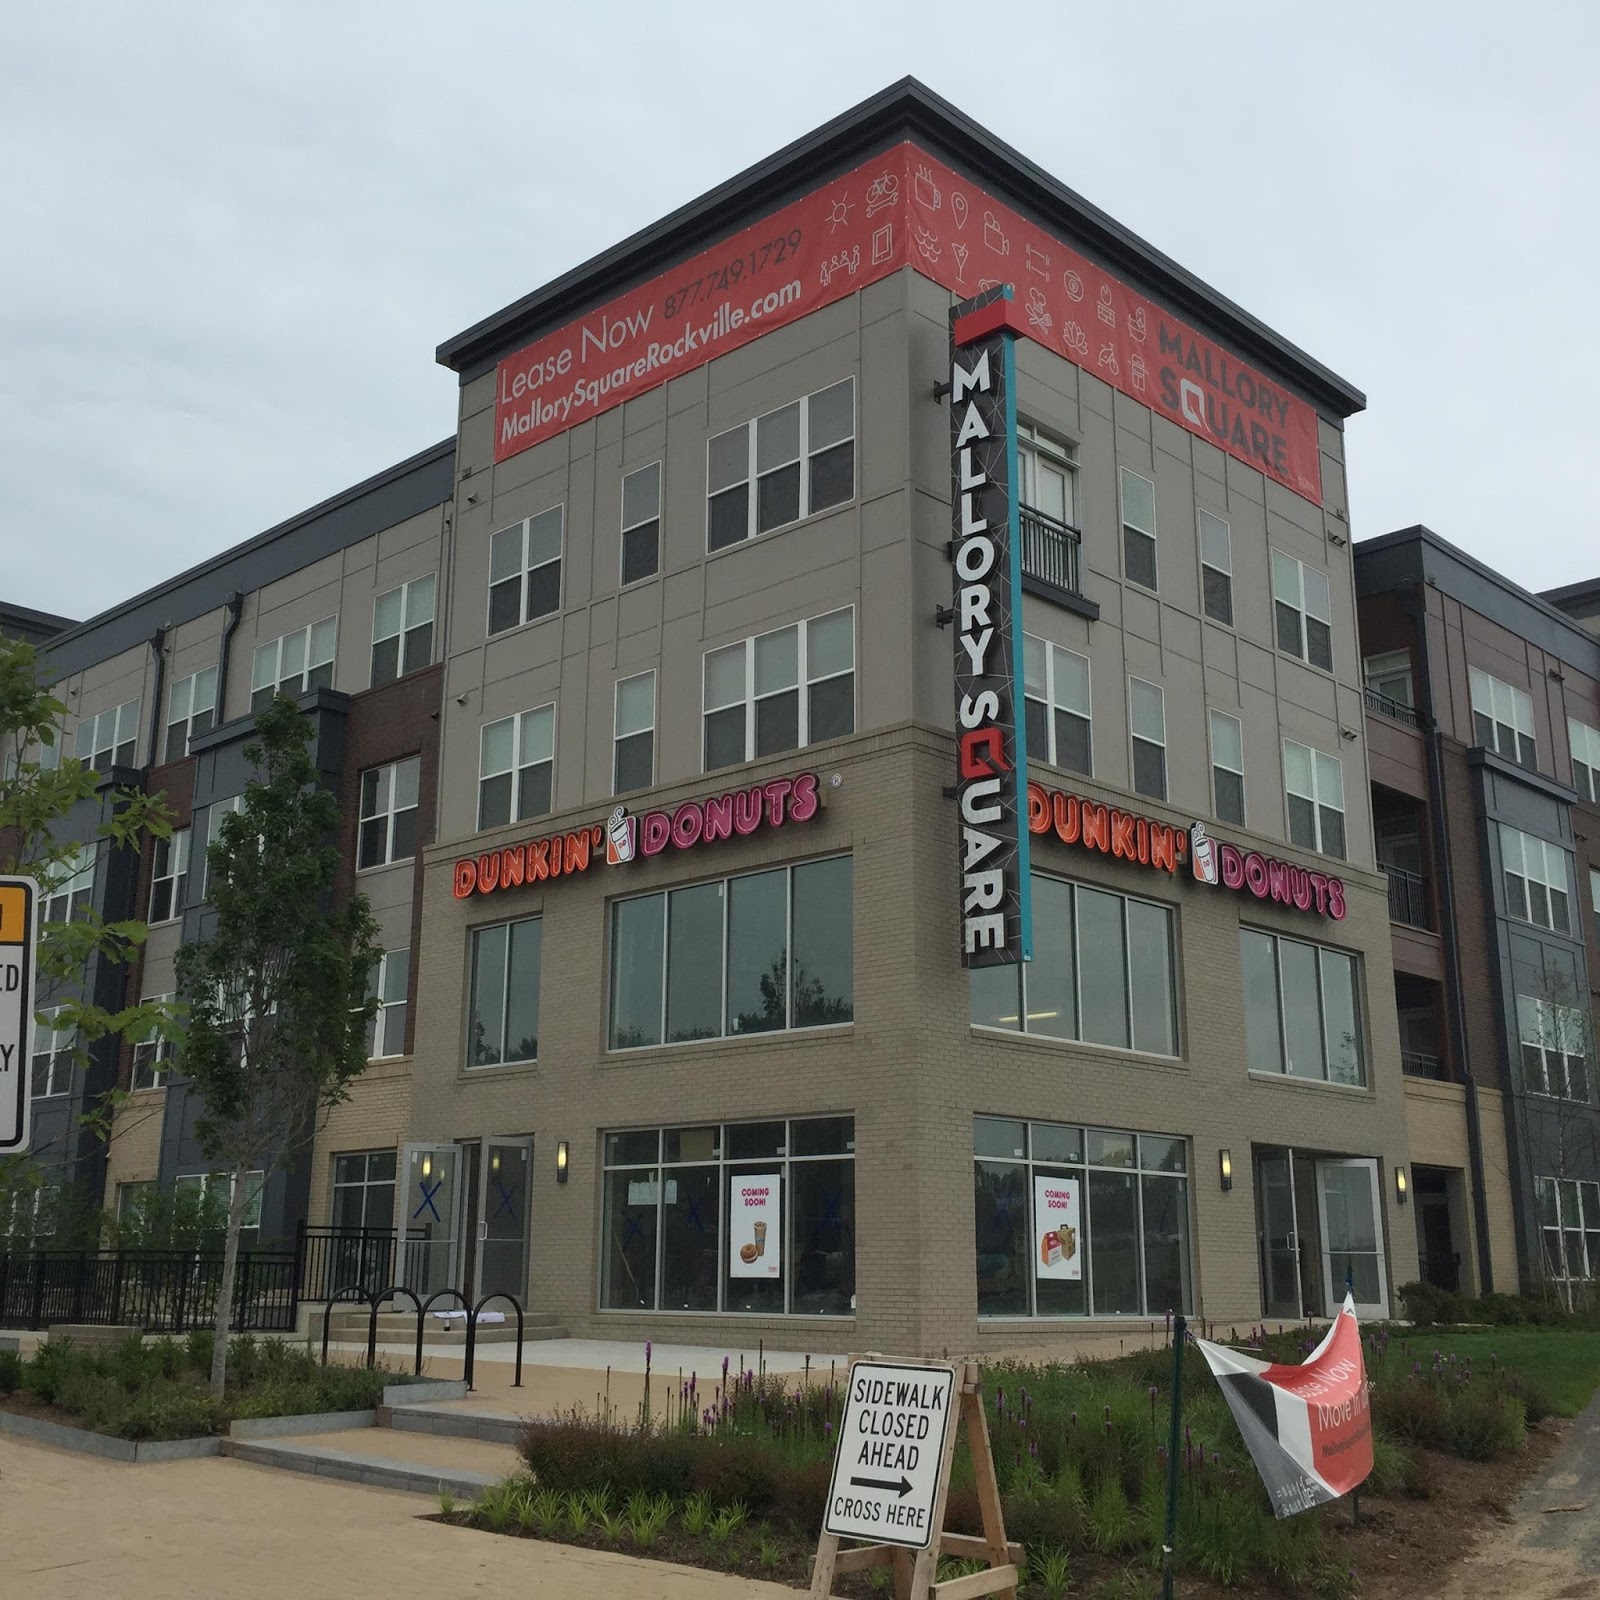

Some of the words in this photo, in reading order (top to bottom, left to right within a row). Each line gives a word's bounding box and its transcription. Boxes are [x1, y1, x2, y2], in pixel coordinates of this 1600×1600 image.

[501, 347, 572, 404] Lease
[581, 304, 654, 363] Now
[664, 228, 802, 320] 877.749.1729
[501, 278, 801, 444] MallorySquareRockville.com
[1159, 320, 1289, 430] MALLORY
[1159, 366, 1289, 477] SQUARE
[952, 348, 995, 677] MALLORY
[453, 824, 605, 899] DUNKIN'
[641, 772, 821, 857] DONUTS
[960, 689, 1012, 954] SQUARE
[1028, 781, 1187, 873] DUNKIN'
[1217, 842, 1347, 921] DONUTS
[741, 1188, 769, 1197] COMING
[744, 1198, 766, 1207] SOON!
[1045, 1189, 1070, 1200] COMING
[1048, 1200, 1068, 1209] SOON!
[1309, 1358, 1358, 1387] Now
[854, 1378, 944, 1410] SIDEWALK
[859, 1409, 929, 1440] CLOSED
[1316, 1400, 1352, 1431] Move
[857, 1440, 919, 1471] AHEAD
[834, 1496, 881, 1522] CROSS
[886, 1503, 925, 1529] HERE
